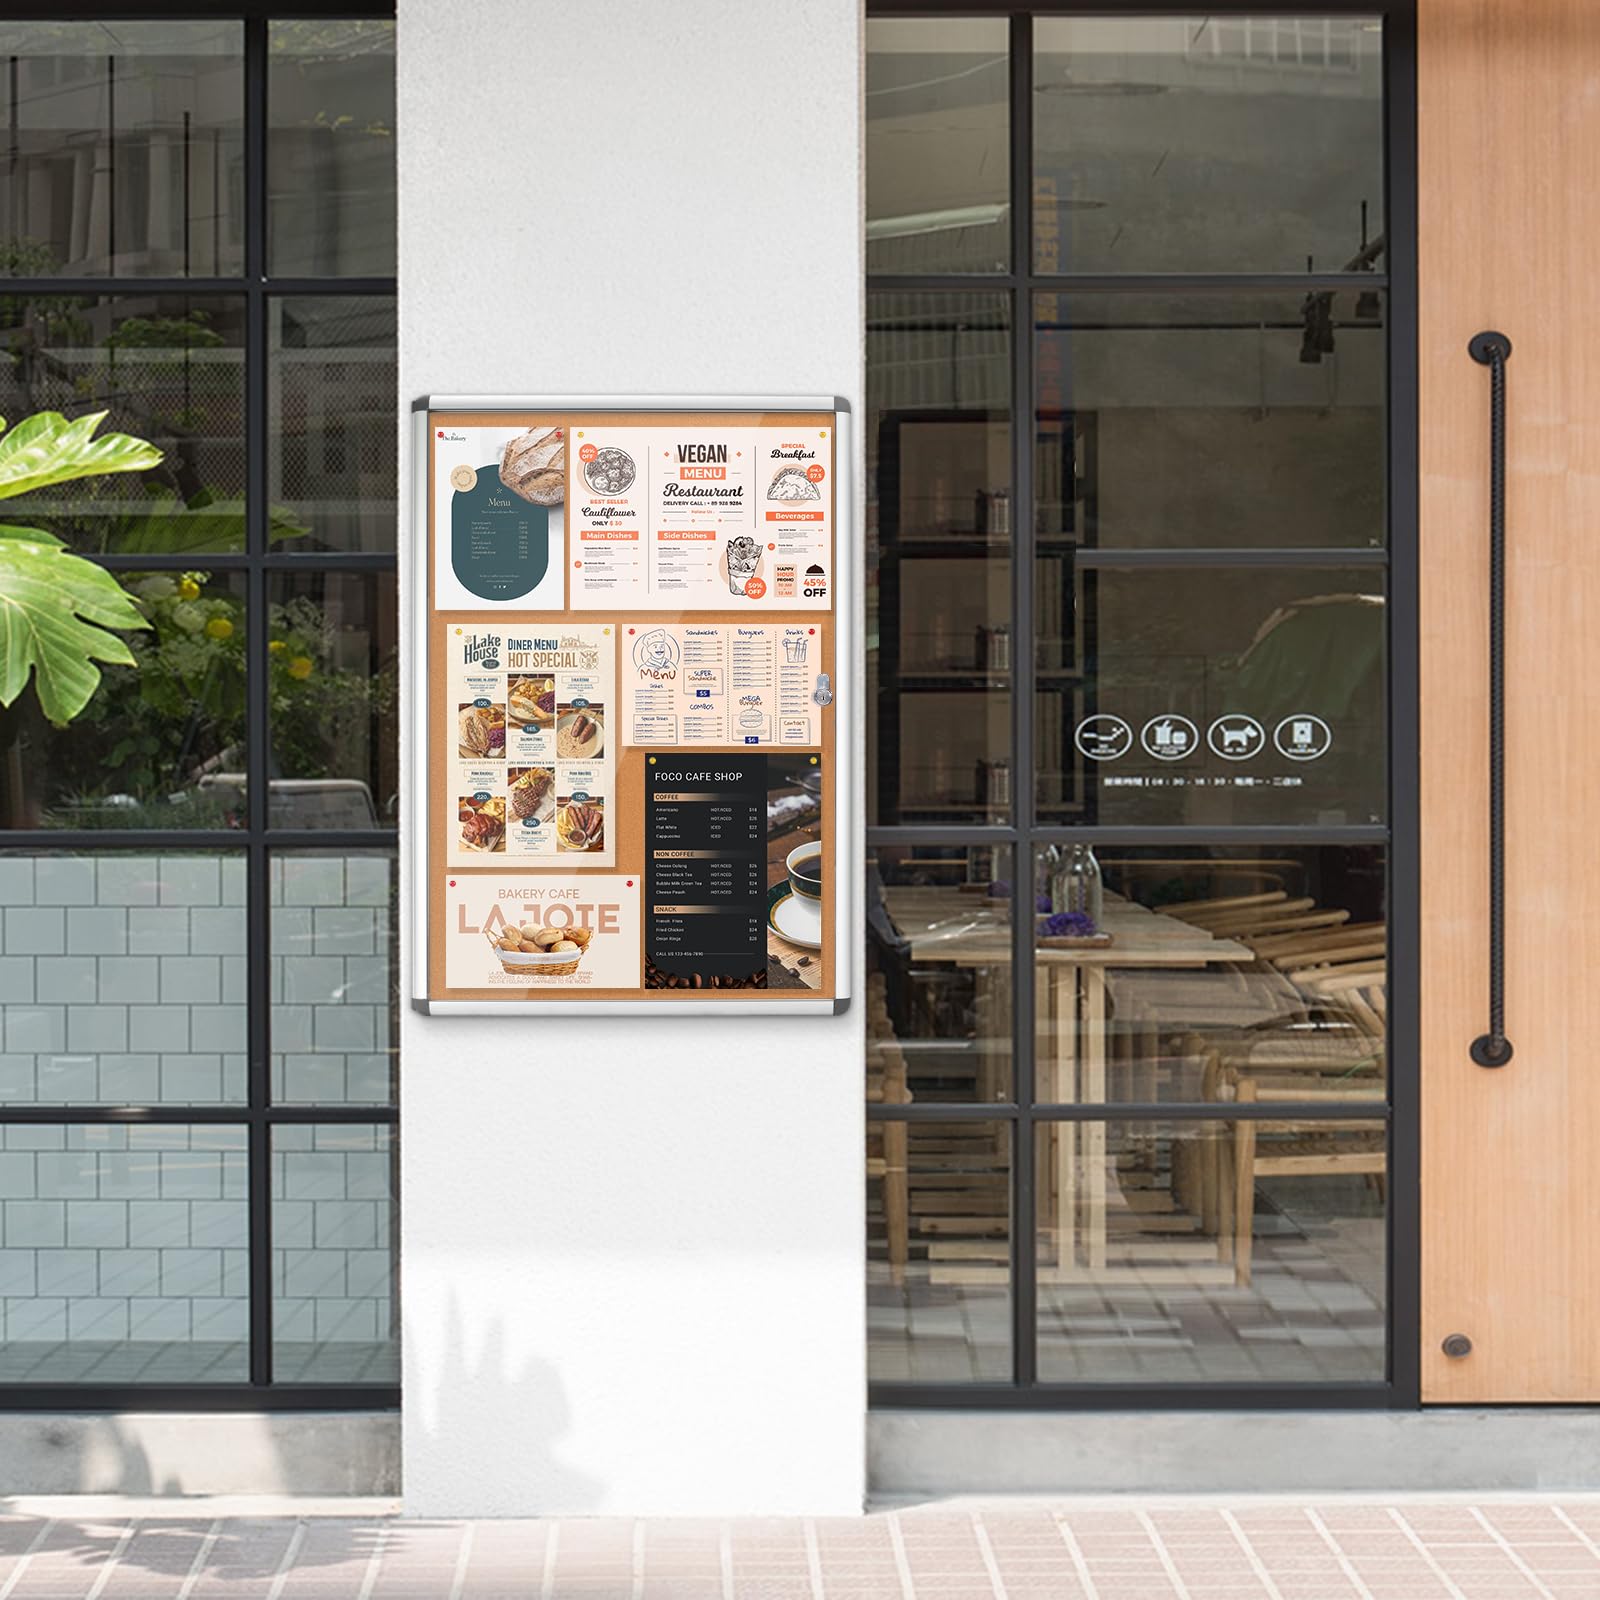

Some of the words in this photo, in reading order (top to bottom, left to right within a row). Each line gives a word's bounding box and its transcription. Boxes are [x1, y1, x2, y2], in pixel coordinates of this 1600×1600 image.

[677, 444, 727, 463] VEGAN
[770, 449, 815, 461] Breakfast
[684, 469, 722, 478] MENU
[663, 482, 744, 497] Restaurant
[488, 498, 510, 507] Menu
[581, 507, 636, 519] Cauliflower
[804, 578, 827, 587] 45%
[803, 588, 827, 597] OFF
[473, 633, 501, 651] Lake
[508, 638, 533, 650] DINER
[534, 638, 558, 650] MENU
[464, 644, 498, 665] House
[508, 652, 531, 668] HOT
[533, 652, 578, 668] SPECIAL
[655, 772, 682, 781] FOCO
[685, 772, 712, 781] CAFE
[714, 772, 743, 781] SHOP
[498, 889, 545, 899] BAKERY
[549, 889, 580, 899] CAFE
[458, 903, 507, 934] LA
[519, 903, 620, 934] JOIE
